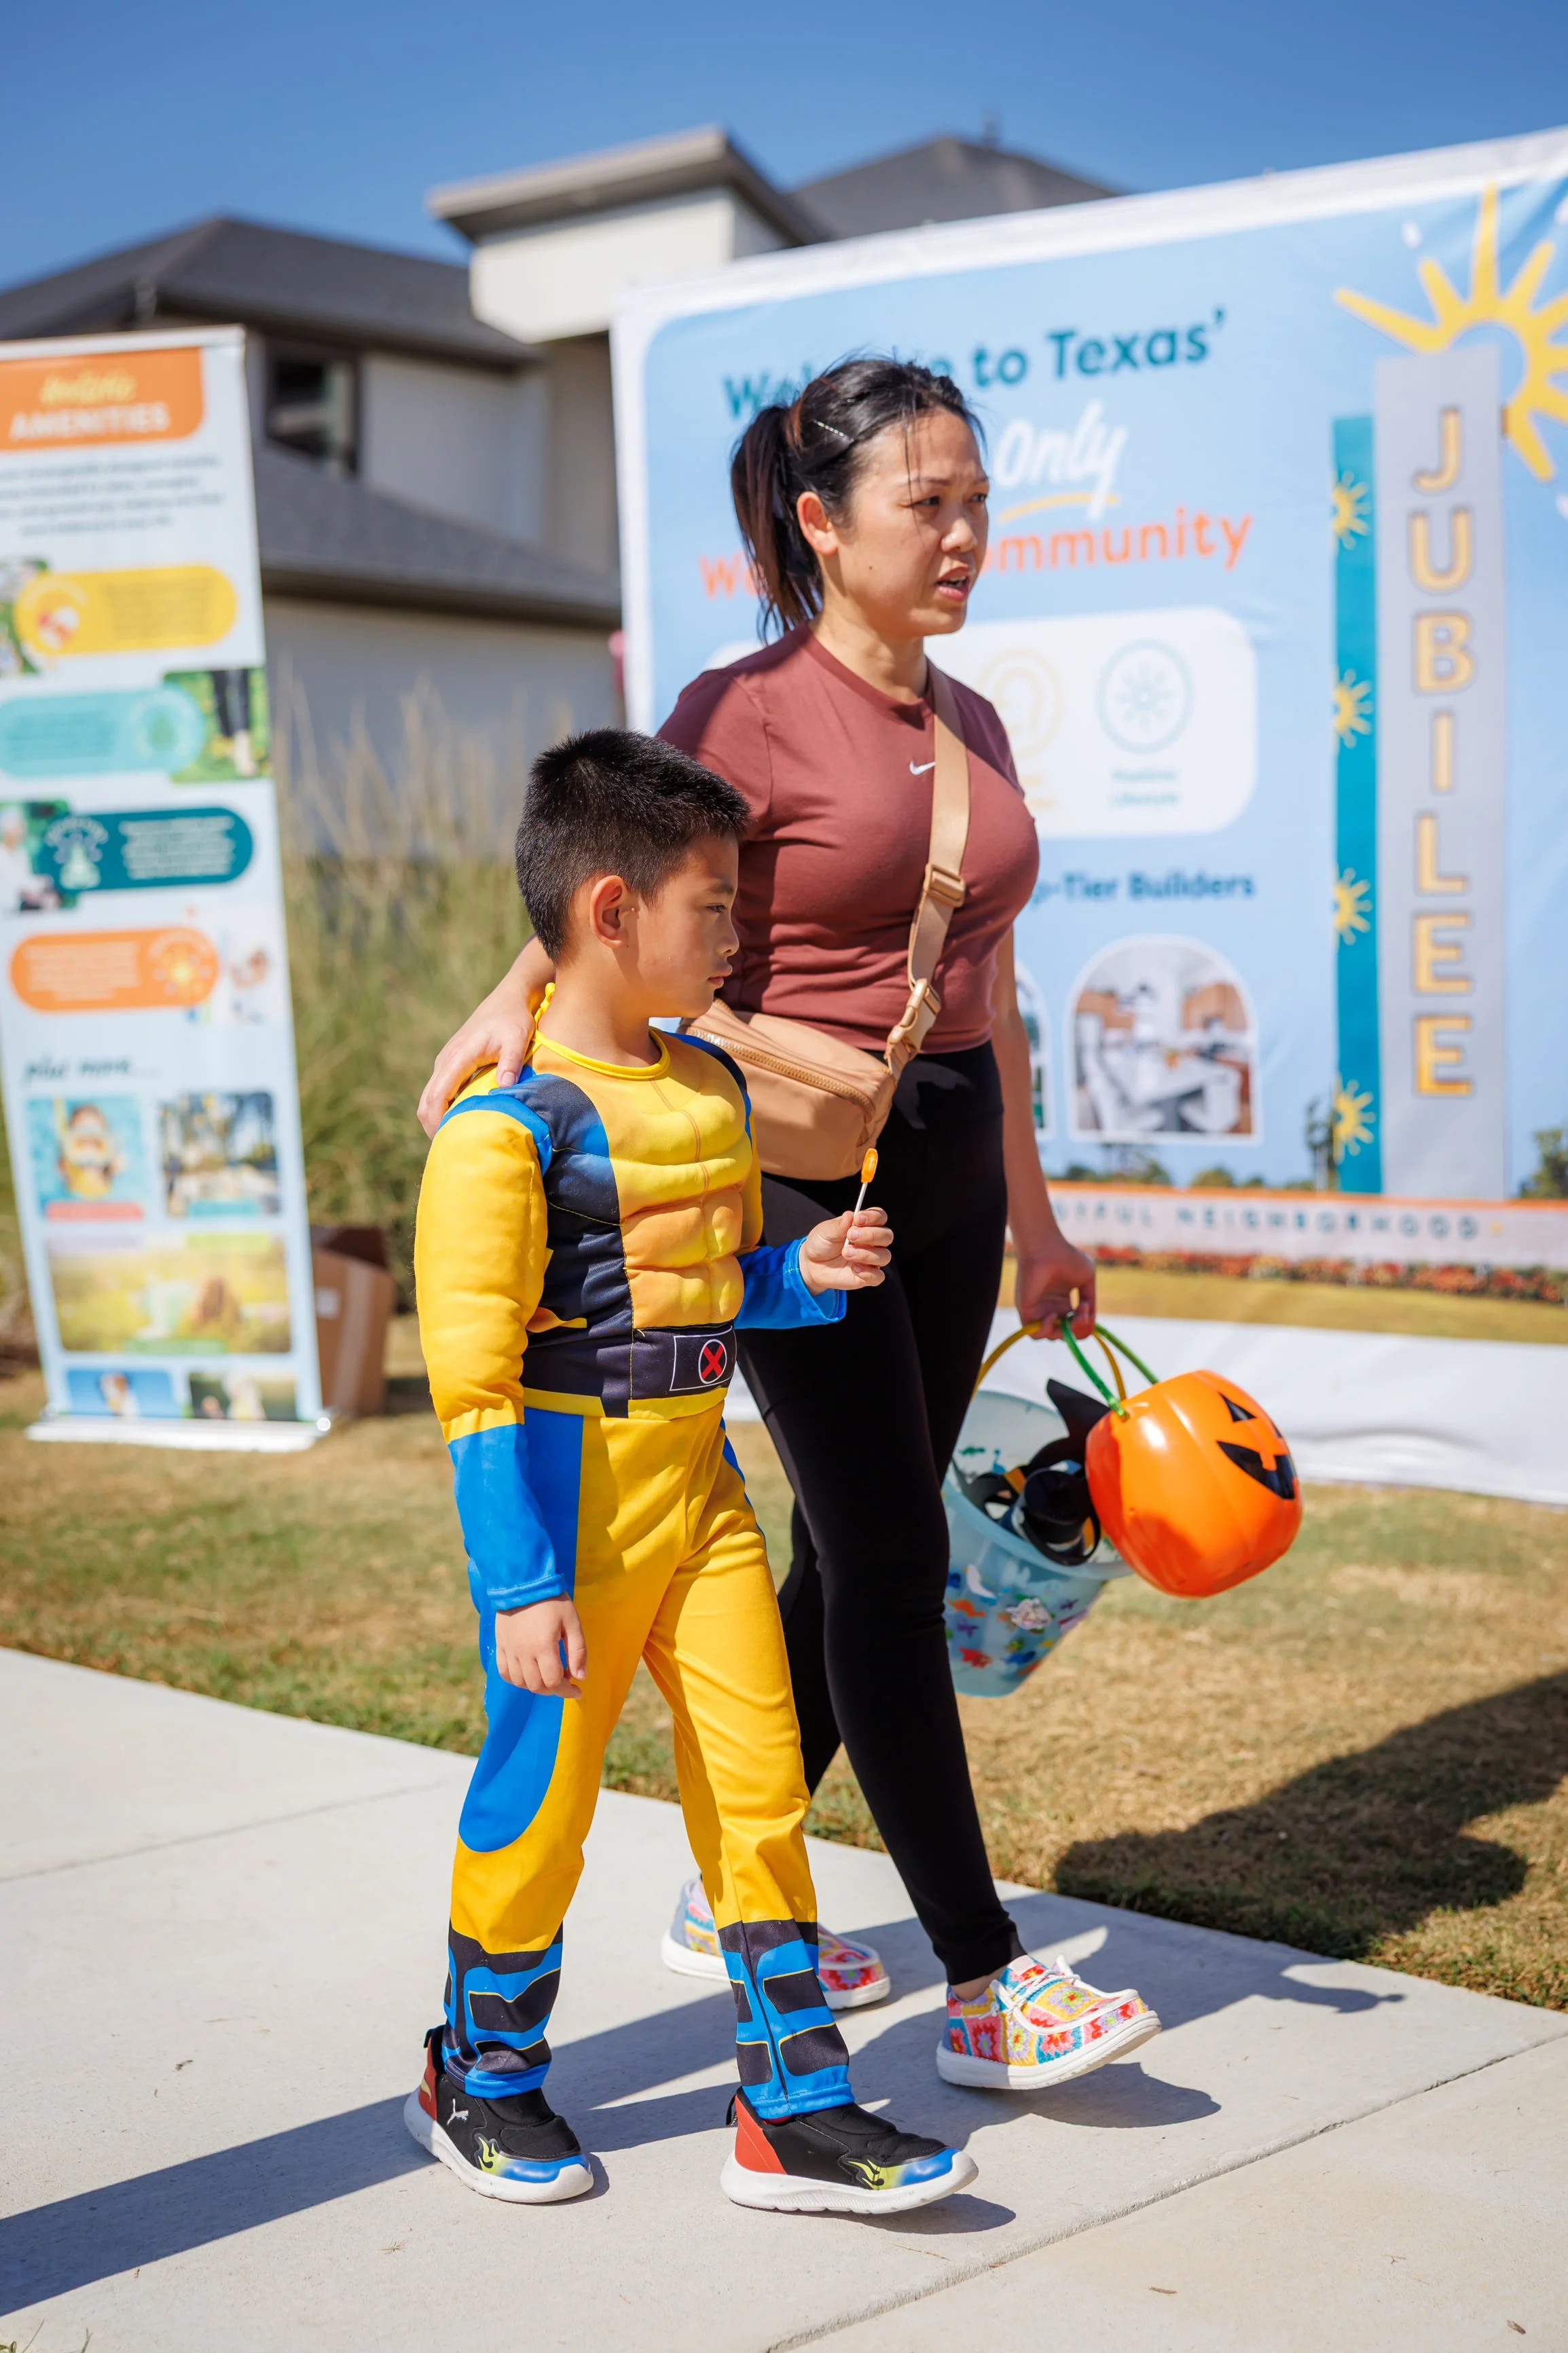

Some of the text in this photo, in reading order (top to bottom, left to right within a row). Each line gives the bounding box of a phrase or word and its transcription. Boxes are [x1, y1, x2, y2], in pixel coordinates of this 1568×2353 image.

[974, 308, 1226, 389] to Texas'
[994, 400, 1129, 520] Only
[982, 506, 1252, 572] mmunity
[1408, 406, 1475, 1096] JUBILEE
[1129, 869, 1256, 900] Builders
[1177, 1206, 1479, 1241] NEIGHBORHOOD
